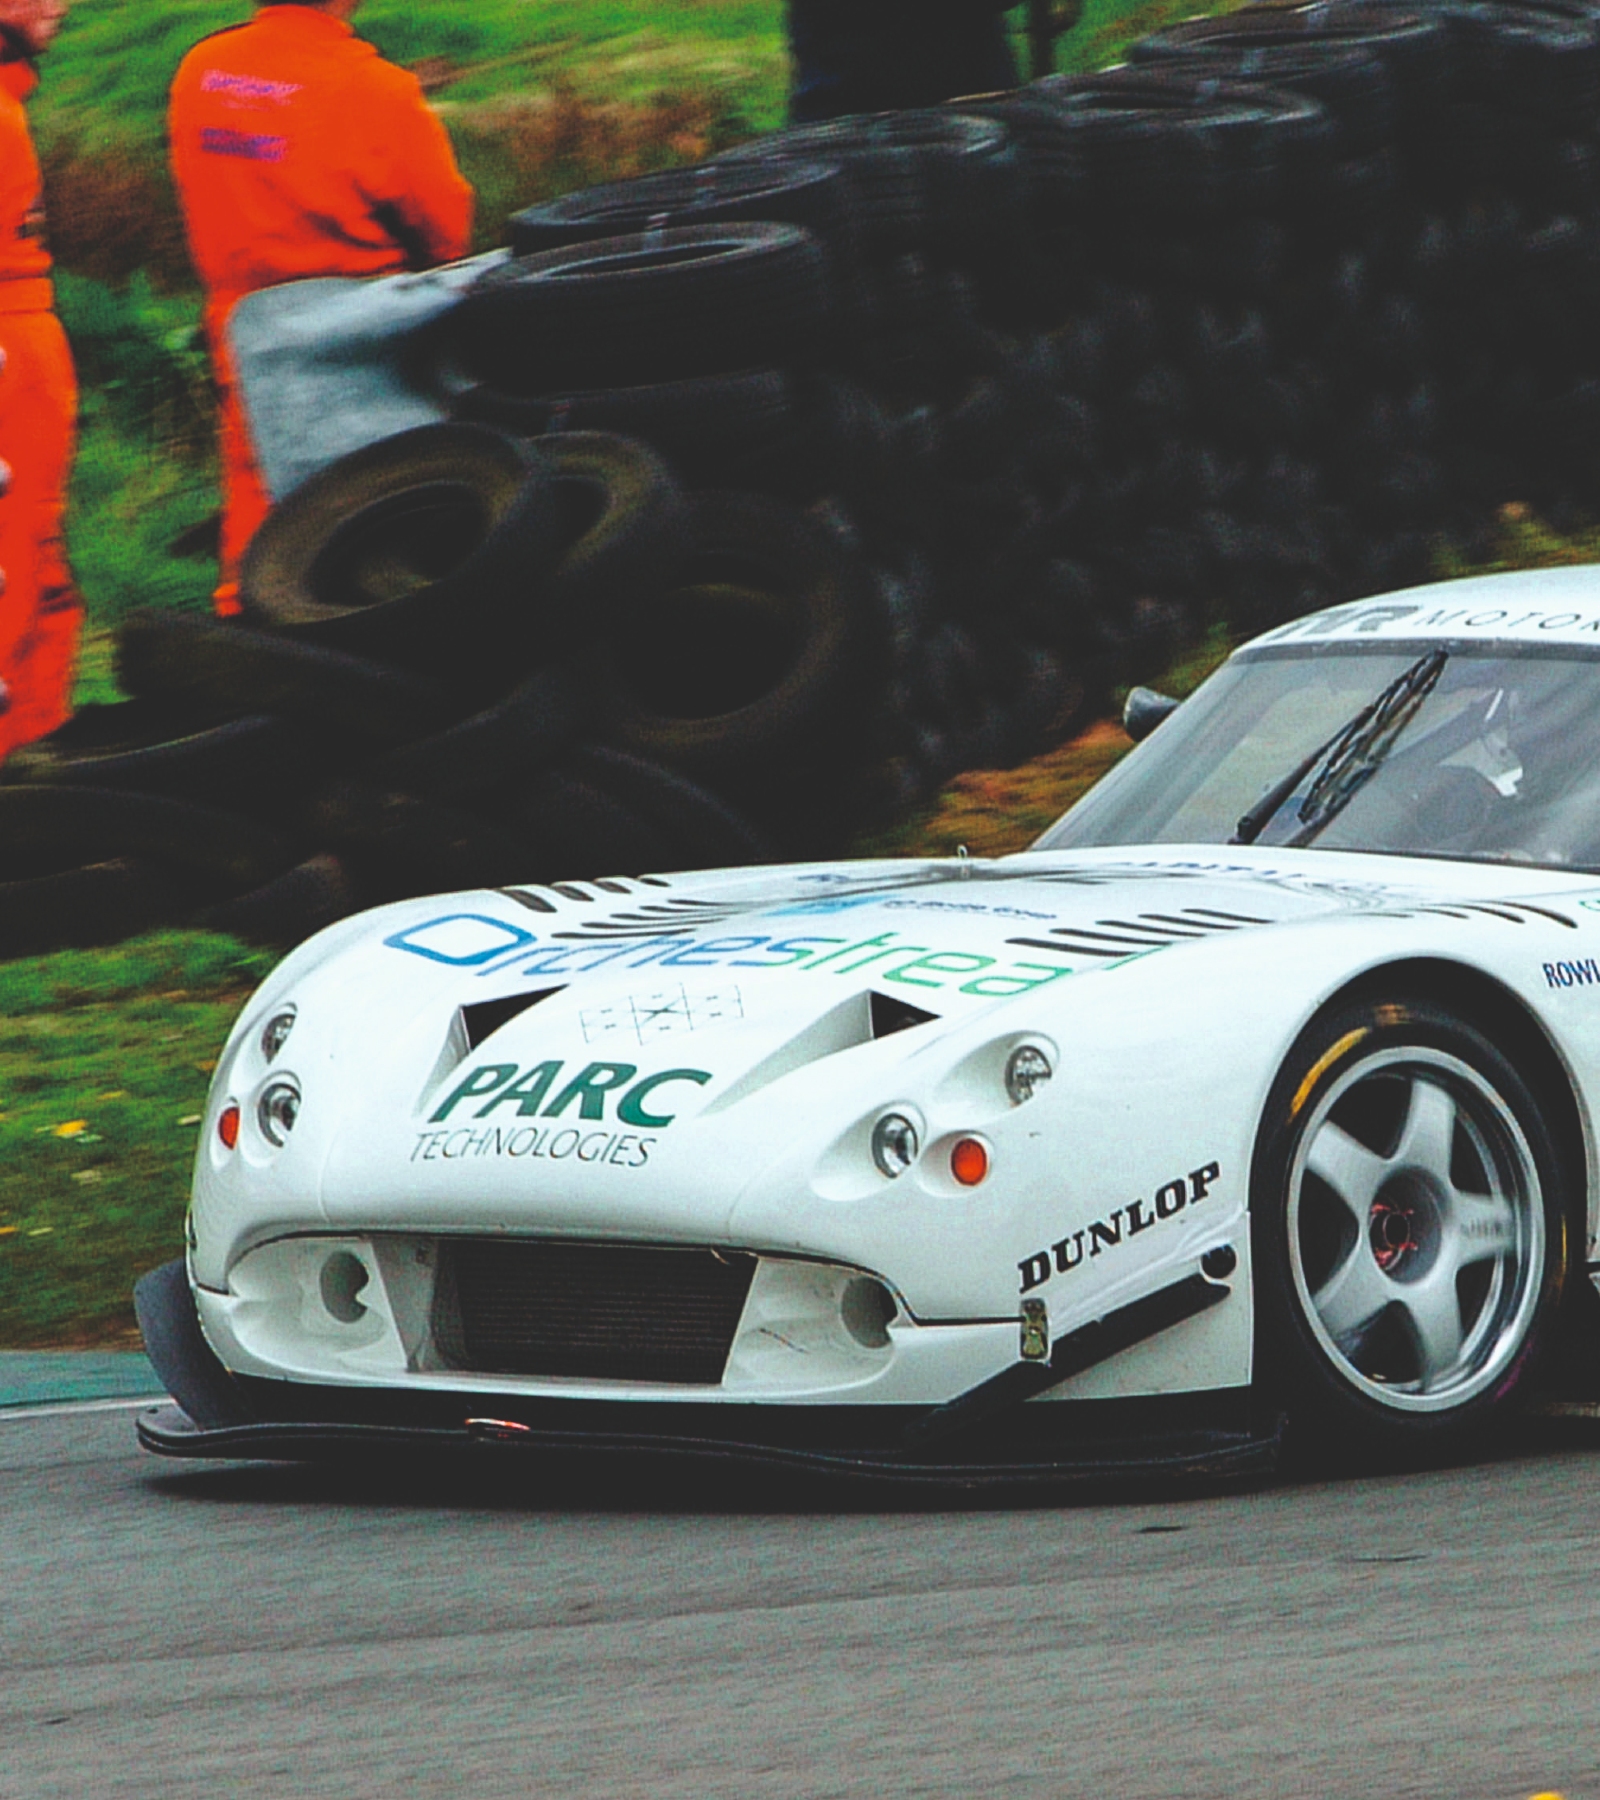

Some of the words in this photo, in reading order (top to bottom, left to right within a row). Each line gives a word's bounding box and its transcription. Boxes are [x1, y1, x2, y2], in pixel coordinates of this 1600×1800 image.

[428, 1060, 712, 1128] PARC
[409, 1125, 659, 1168] TECHNOLOGIES
[1017, 1161, 1222, 1294] DUNLOP
